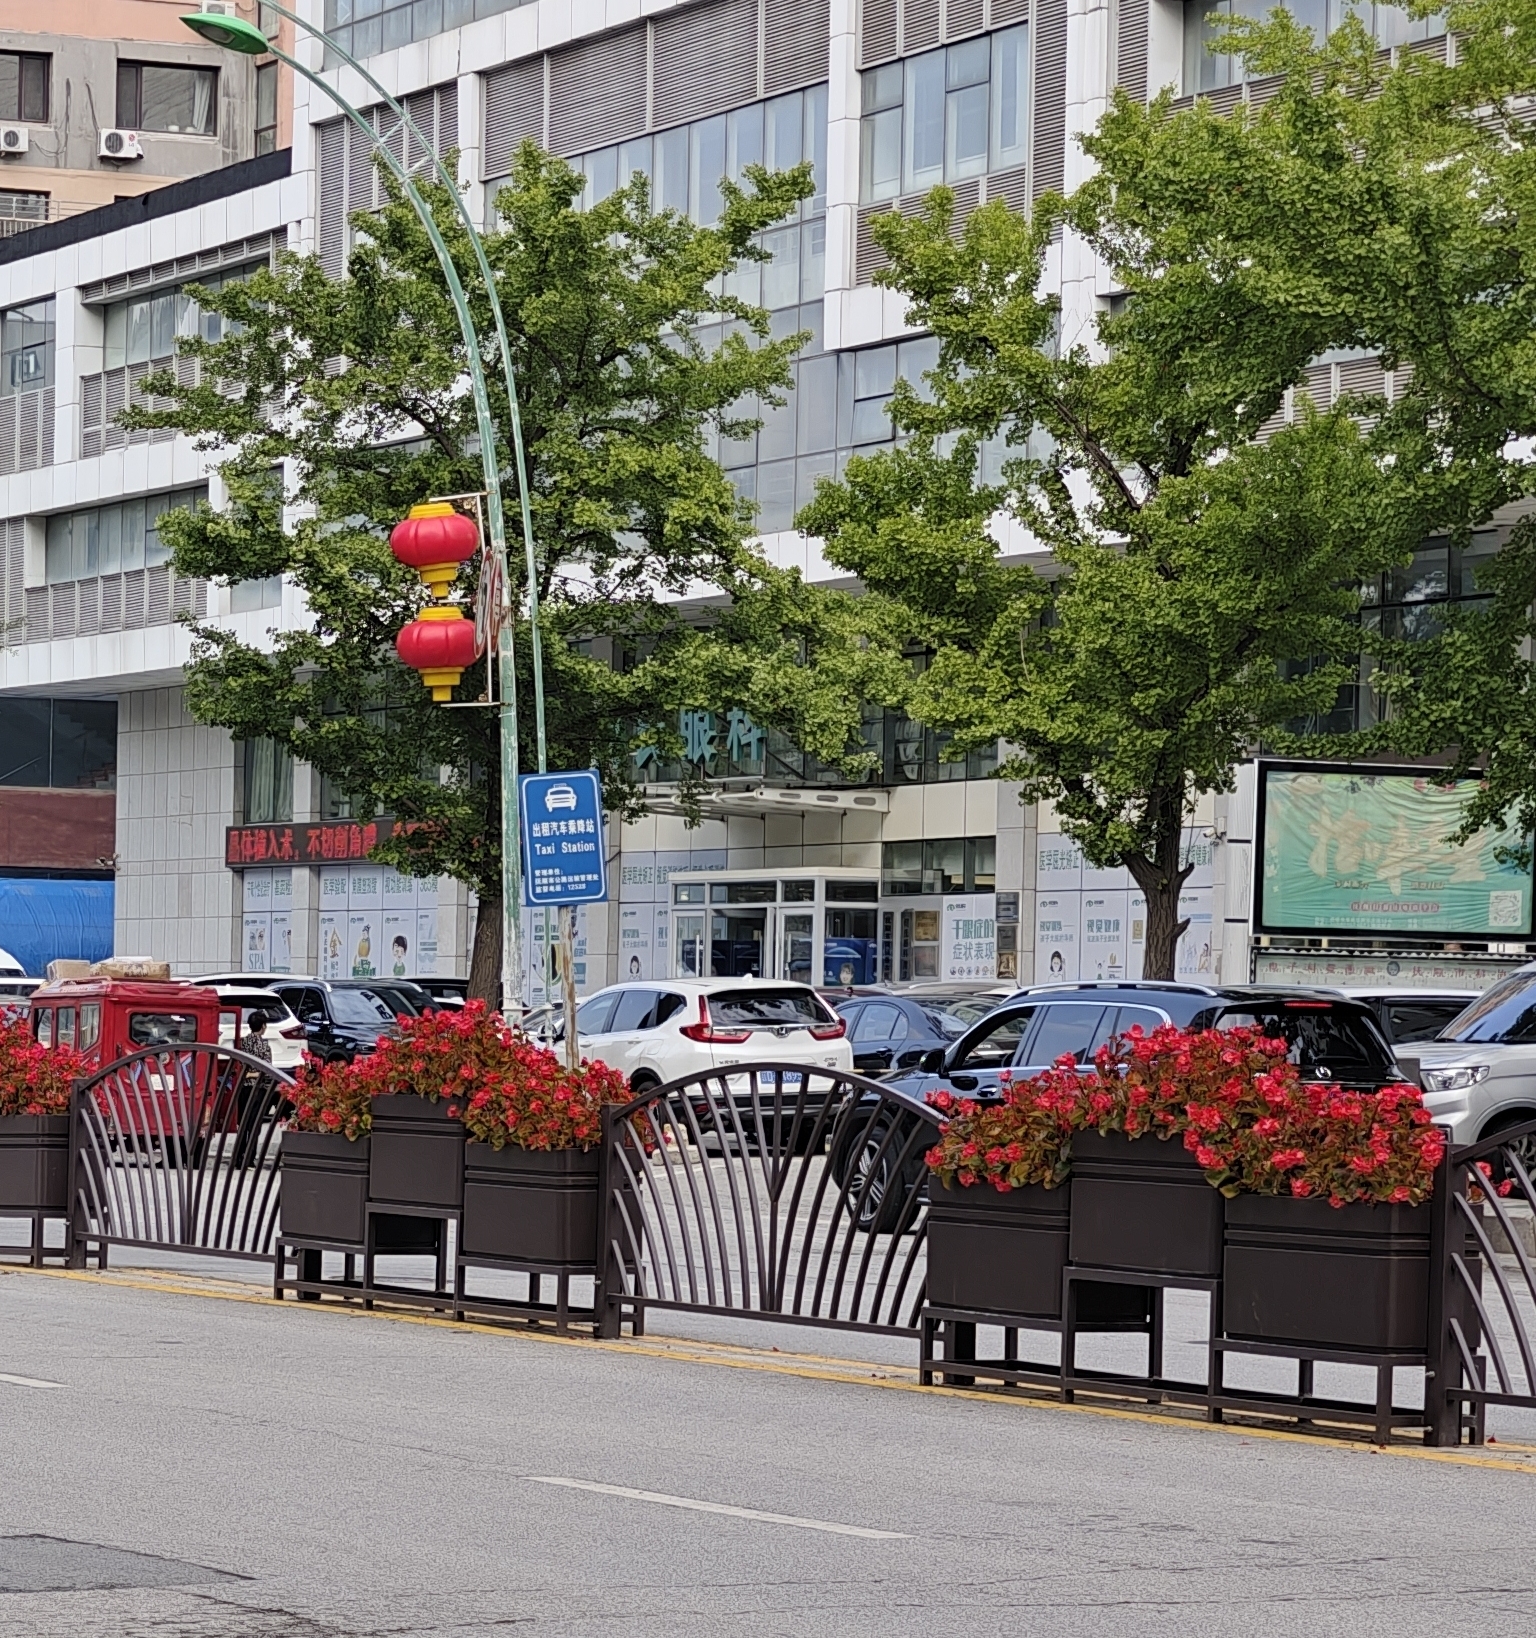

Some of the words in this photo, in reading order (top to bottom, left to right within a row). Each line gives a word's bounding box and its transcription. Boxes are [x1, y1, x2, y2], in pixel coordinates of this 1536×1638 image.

[532, 818, 595, 837] 出租汽车乘降站
[534, 842, 555, 856] Taxi
[561, 840, 596, 854] Station
[951, 918, 995, 940] 干眼症的
[952, 942, 995, 961] 症状表现
[248, 953, 265, 970] SPA
